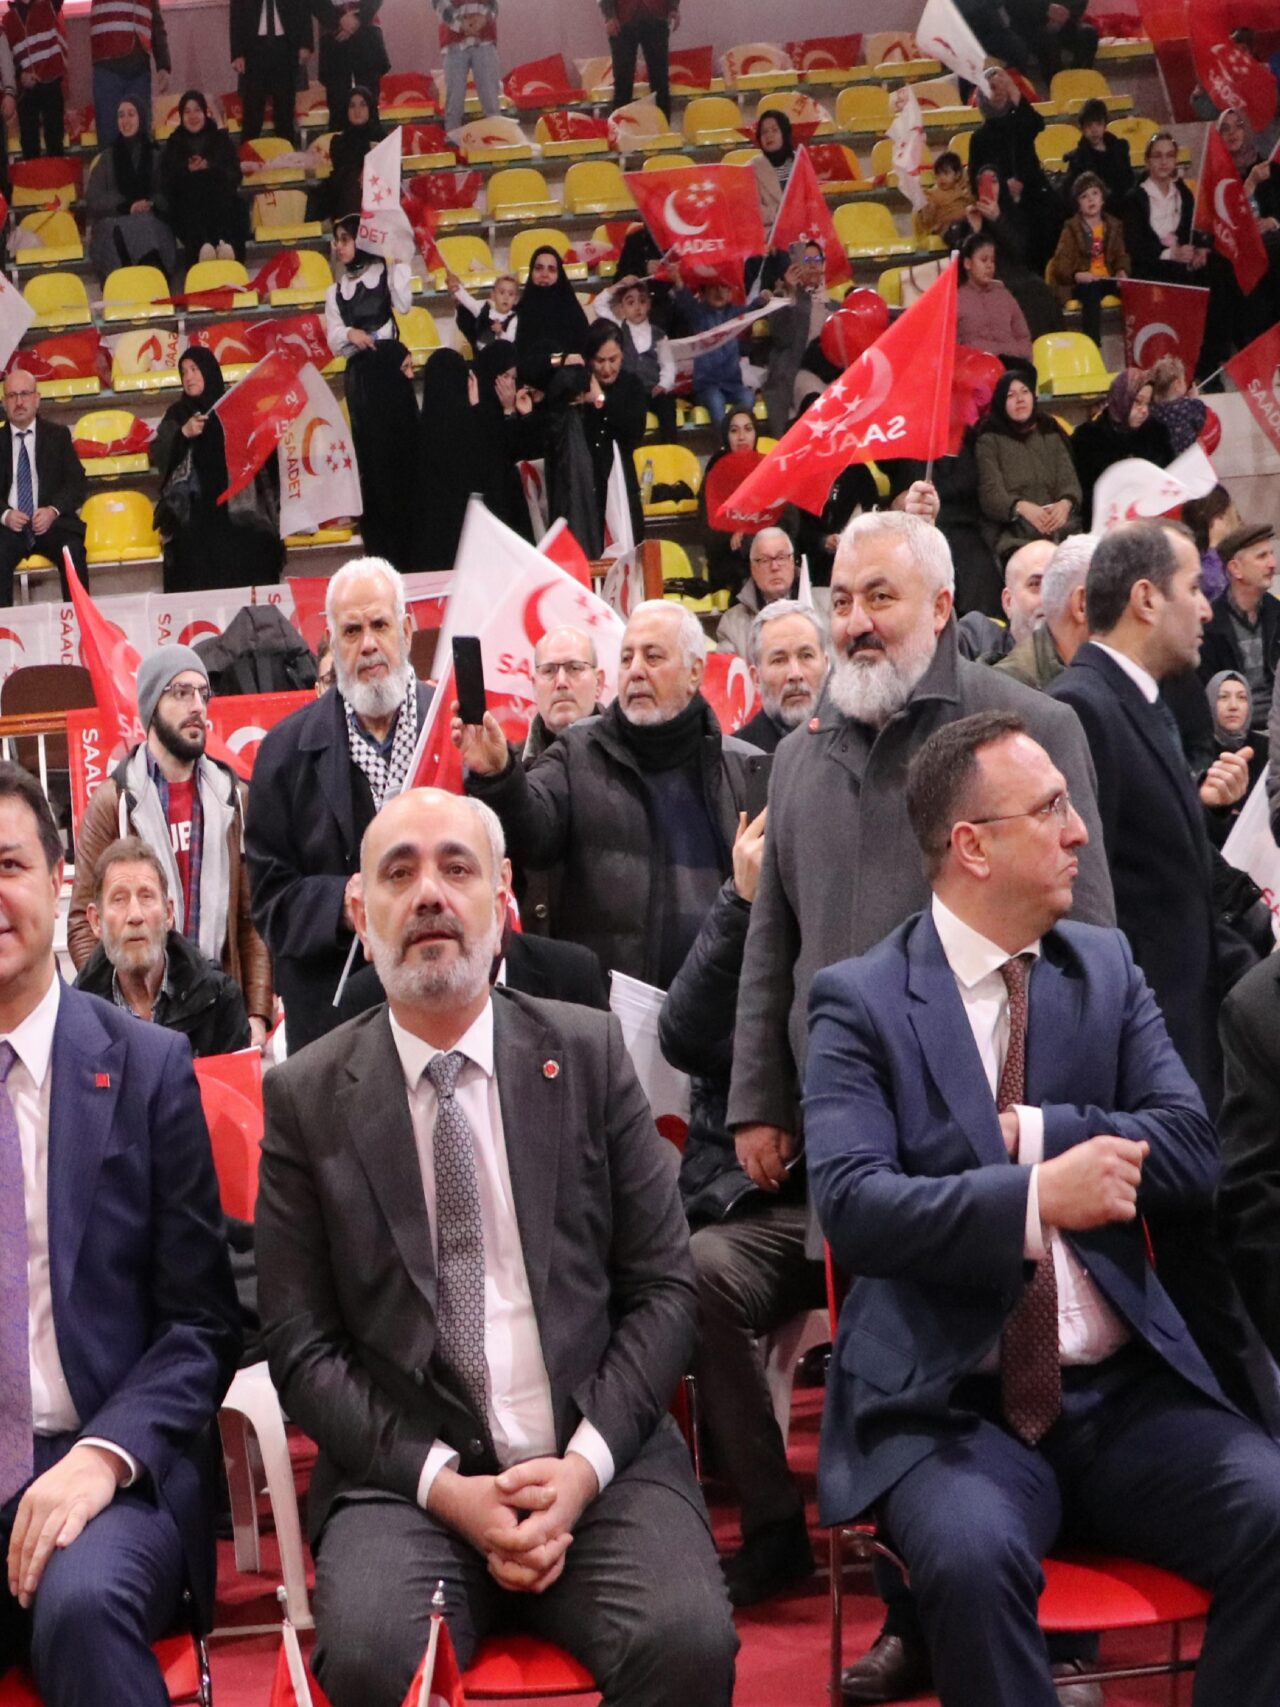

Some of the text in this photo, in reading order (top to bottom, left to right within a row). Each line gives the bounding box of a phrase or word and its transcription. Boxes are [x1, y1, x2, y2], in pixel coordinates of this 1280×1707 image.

[359, 224, 389, 245] DET
[1248, 378, 1280, 438] SAAD
[60, 608, 74, 665] SAAD
